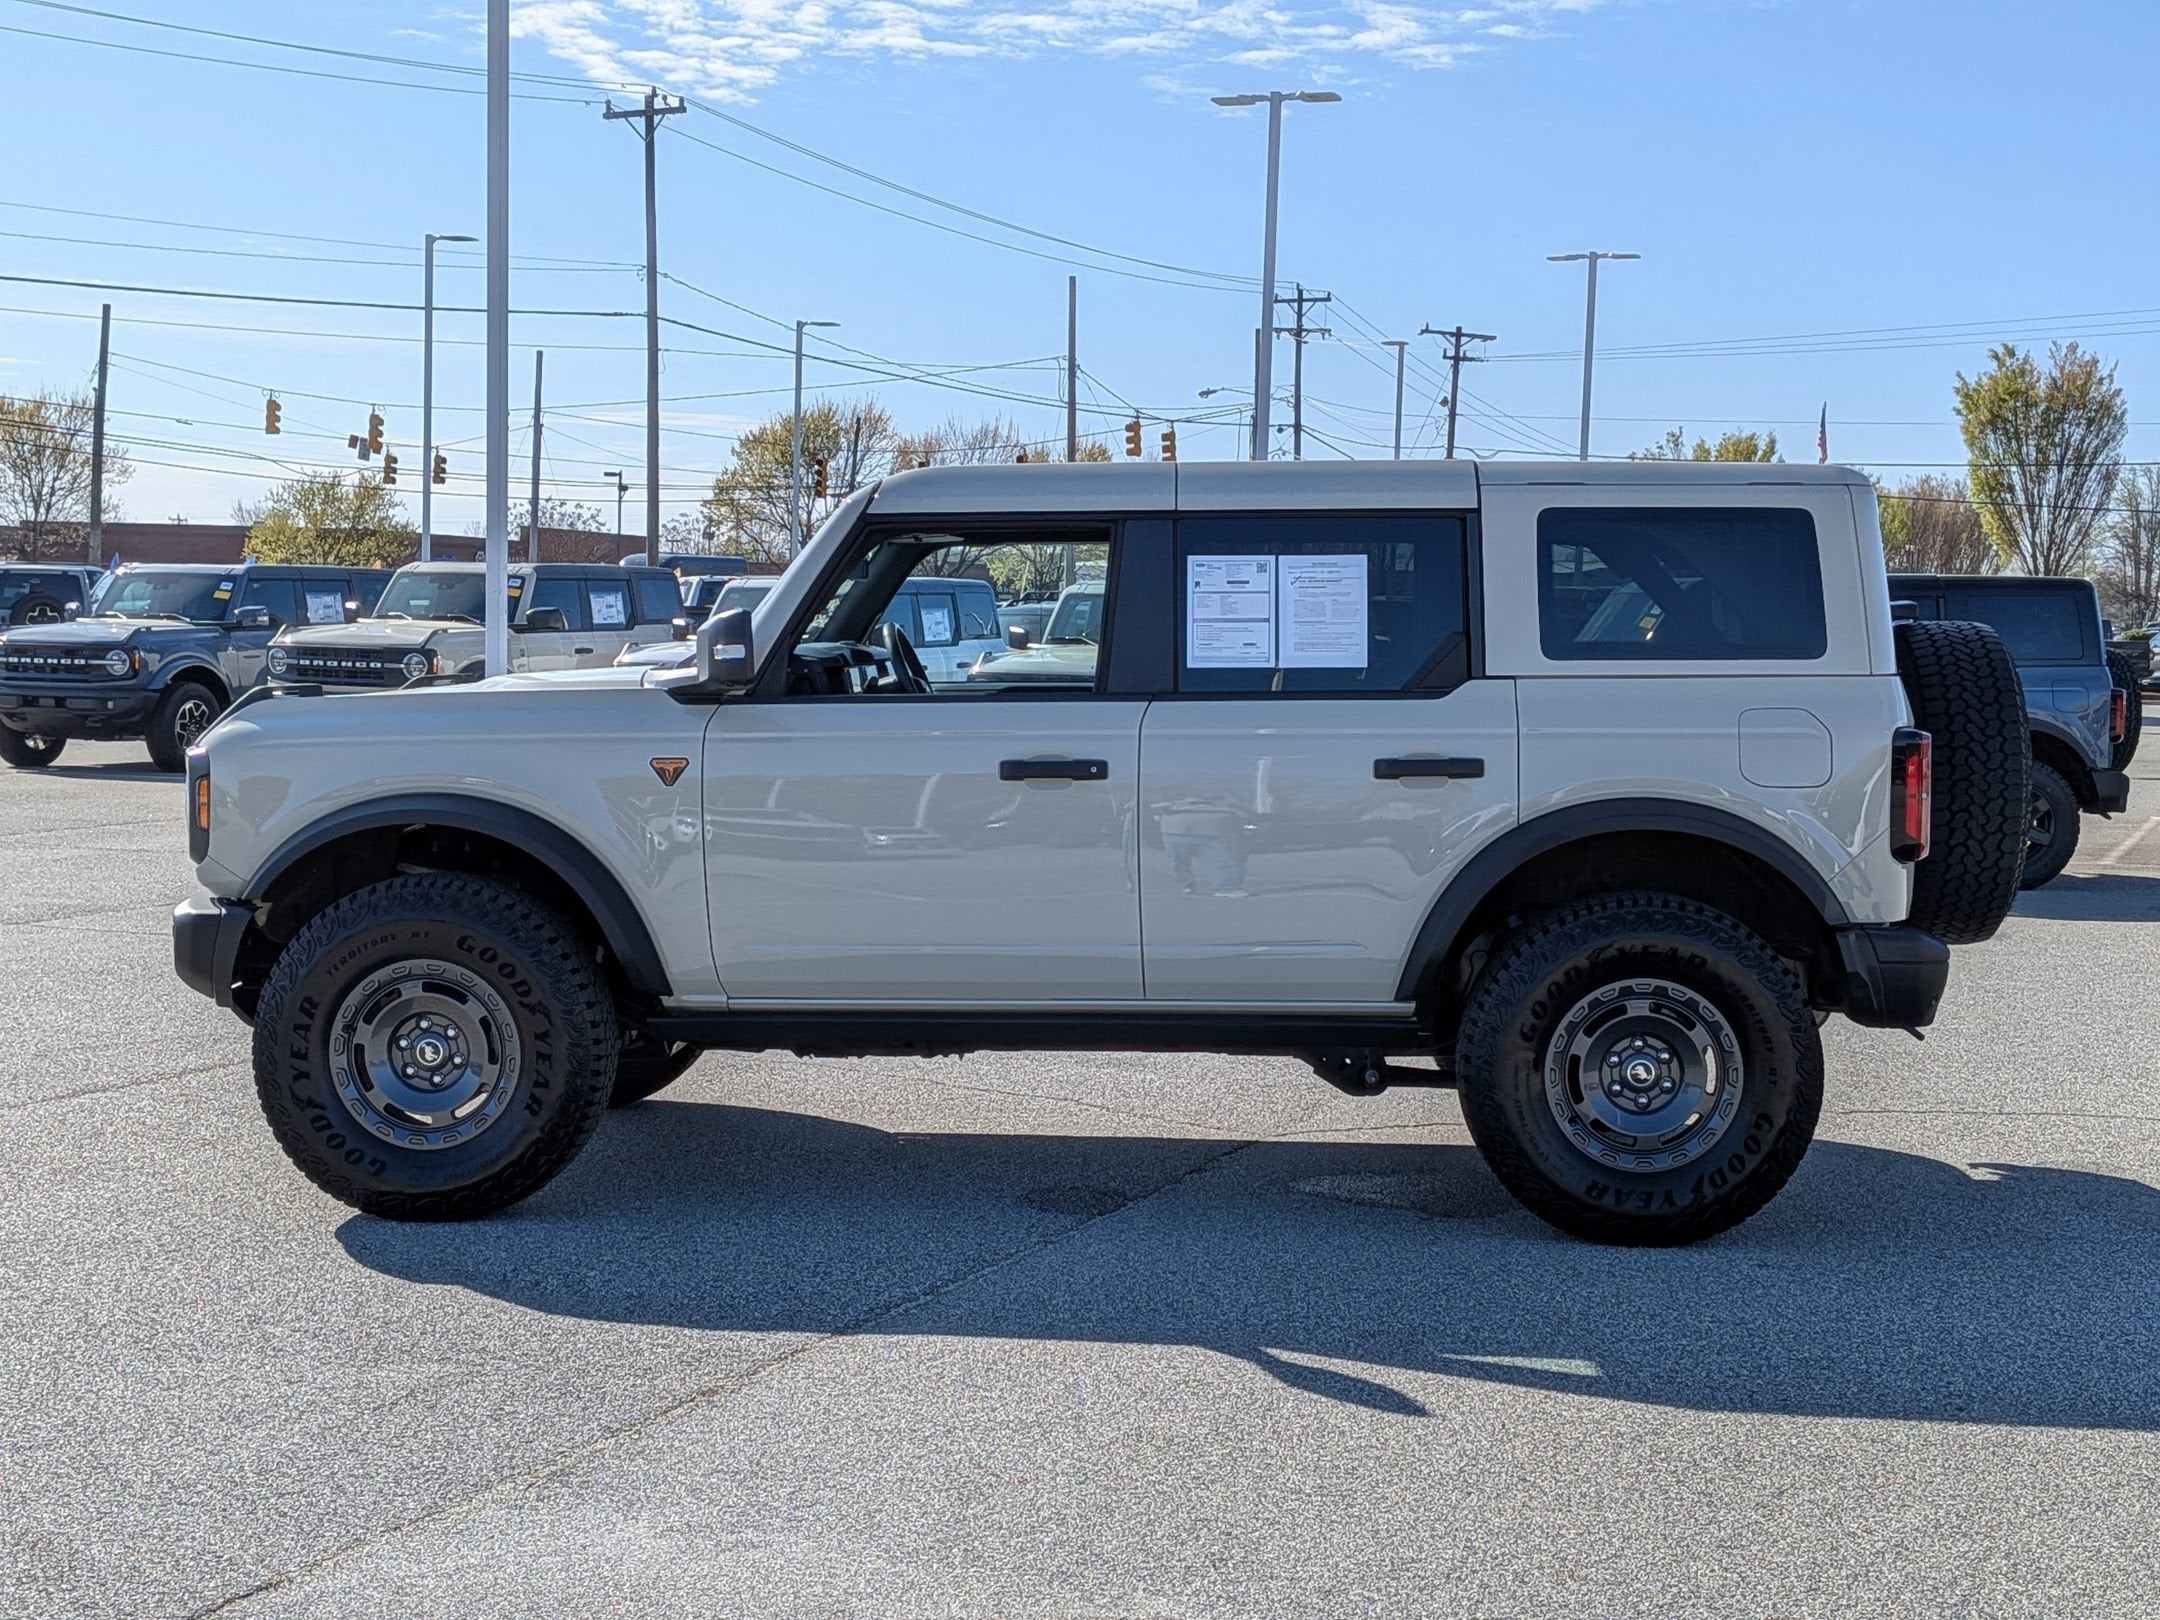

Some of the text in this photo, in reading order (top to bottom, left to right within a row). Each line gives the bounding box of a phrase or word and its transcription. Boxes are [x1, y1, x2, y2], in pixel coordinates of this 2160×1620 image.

[8, 656, 86, 665] BRONCO
[299, 659, 382, 668] BRONCO
[326, 932, 399, 978] TERRITORY
